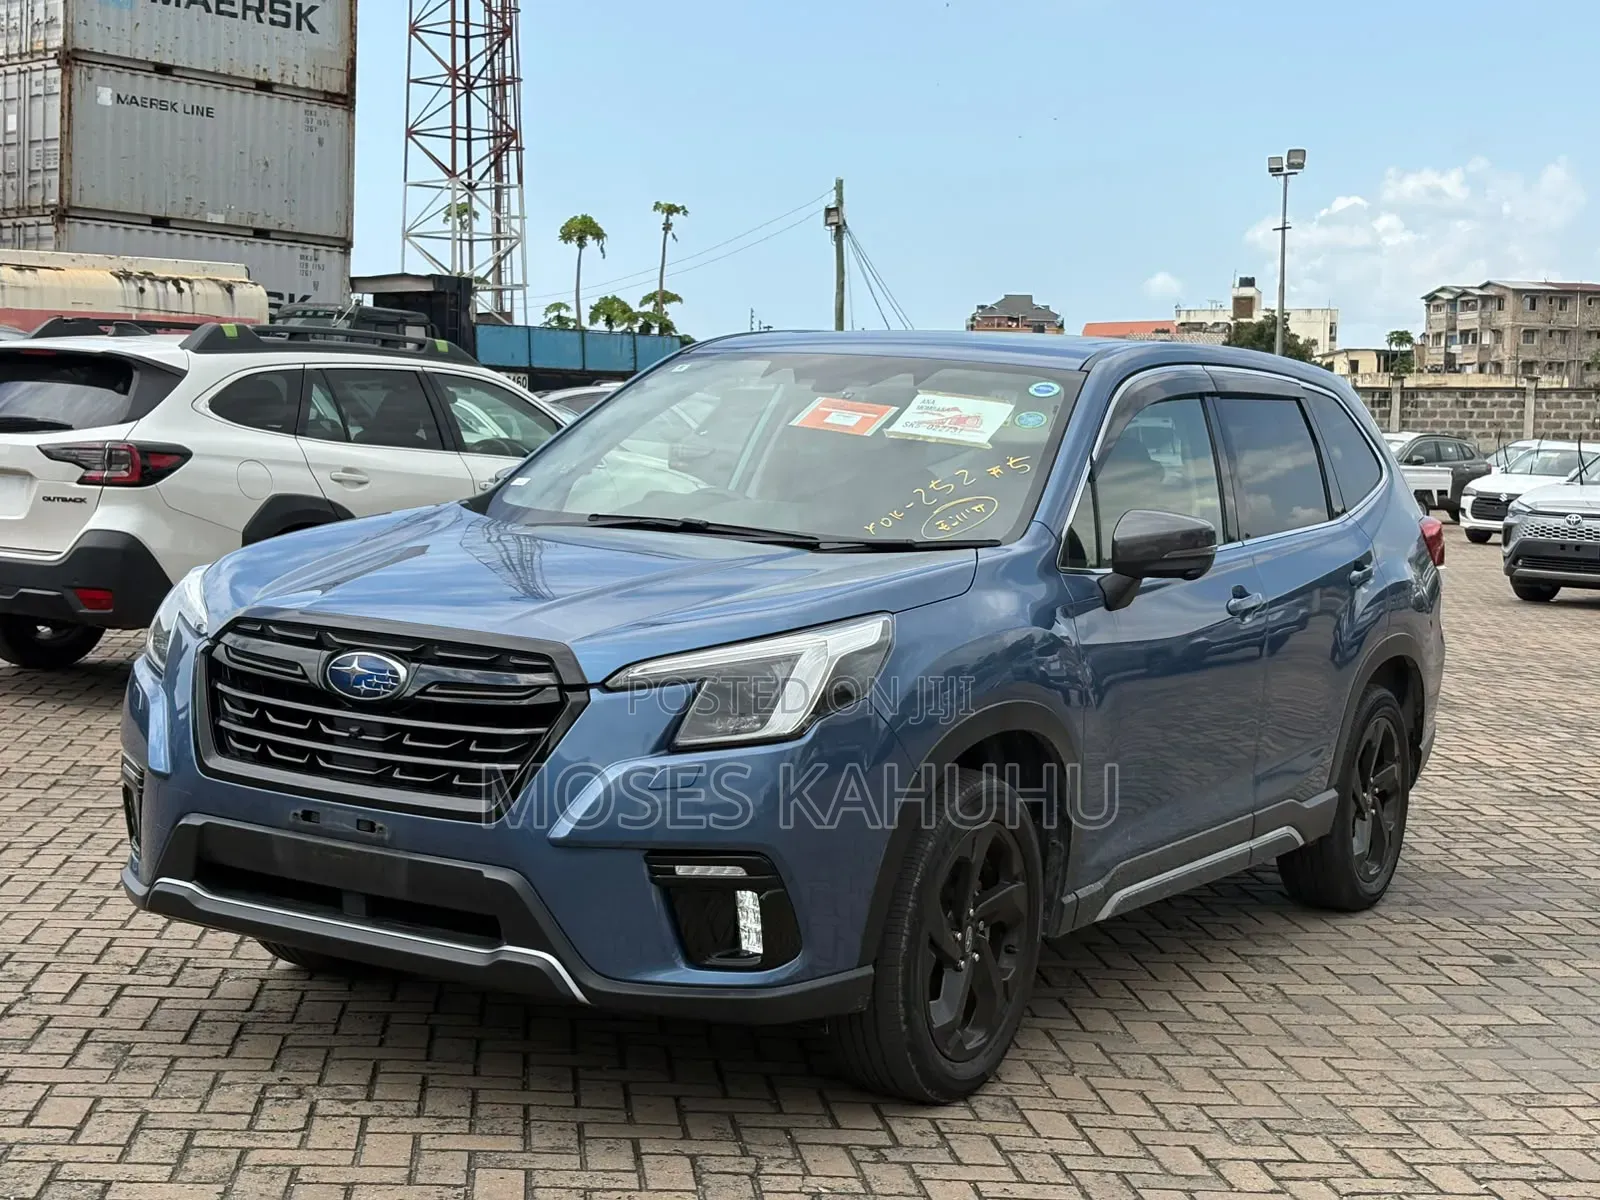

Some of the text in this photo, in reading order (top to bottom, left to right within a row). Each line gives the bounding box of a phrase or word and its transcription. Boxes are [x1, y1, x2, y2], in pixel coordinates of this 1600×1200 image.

[150, 0, 321, 34] ERSK
[116, 92, 215, 119] MAERSK LINE
[41, 495, 88, 505] OUTBACK
